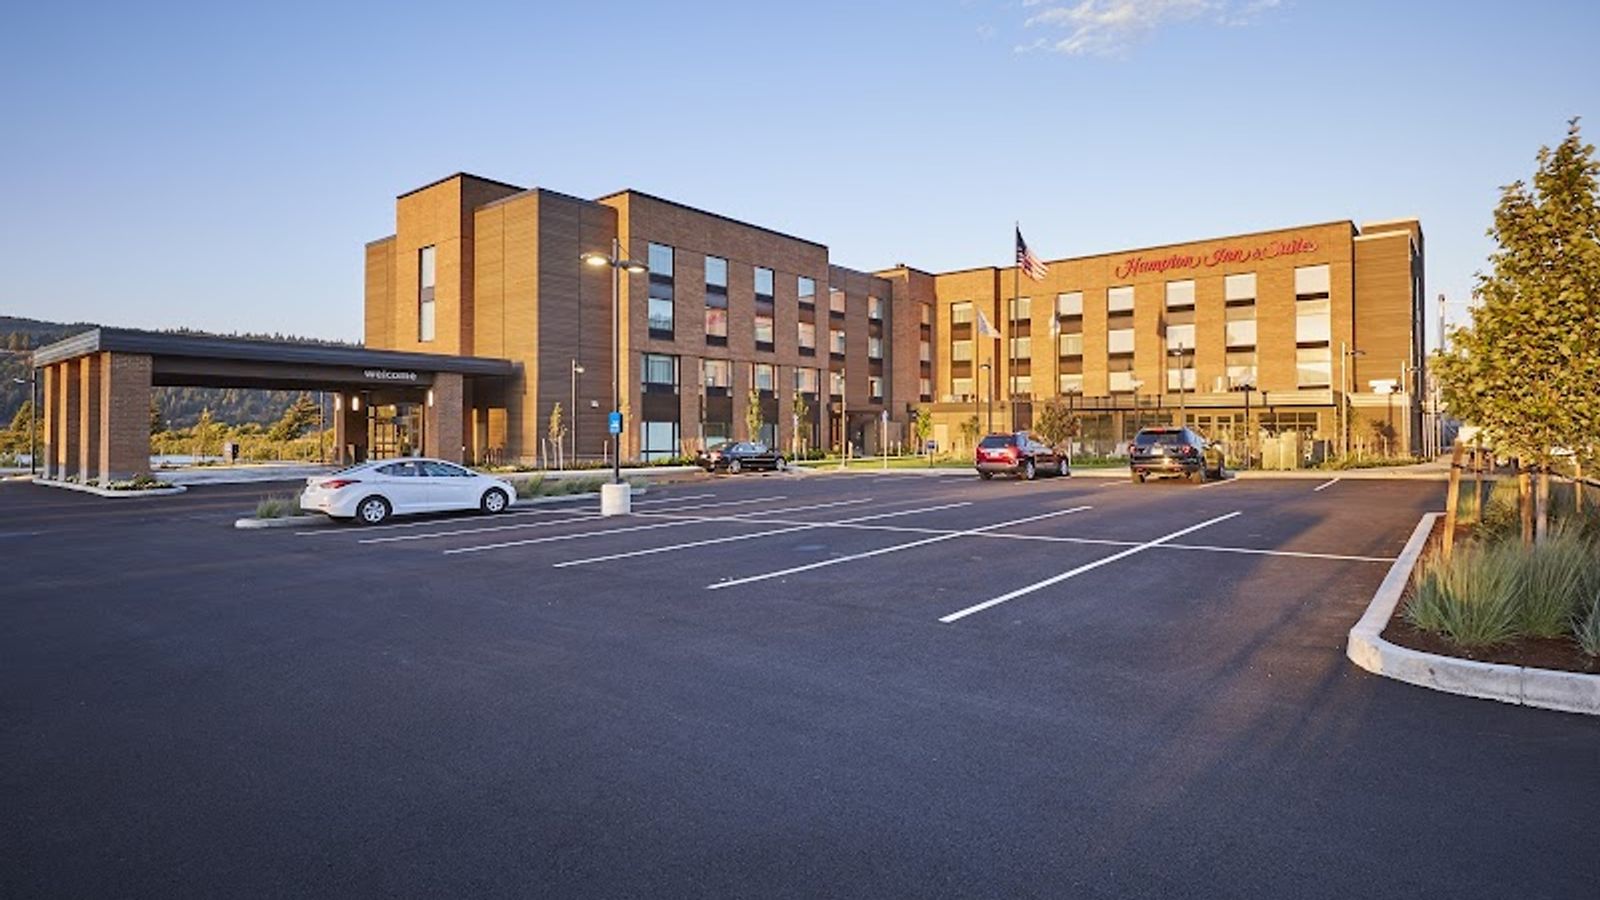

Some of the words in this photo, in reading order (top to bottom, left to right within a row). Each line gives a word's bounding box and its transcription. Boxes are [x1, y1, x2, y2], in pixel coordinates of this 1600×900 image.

[1116, 254, 1201, 279] Hampton
[1203, 248, 1251, 267] Inn
[1252, 249, 1264, 261] &
[1265, 238, 1319, 258] Suites
[364, 370, 417, 381] welcome
